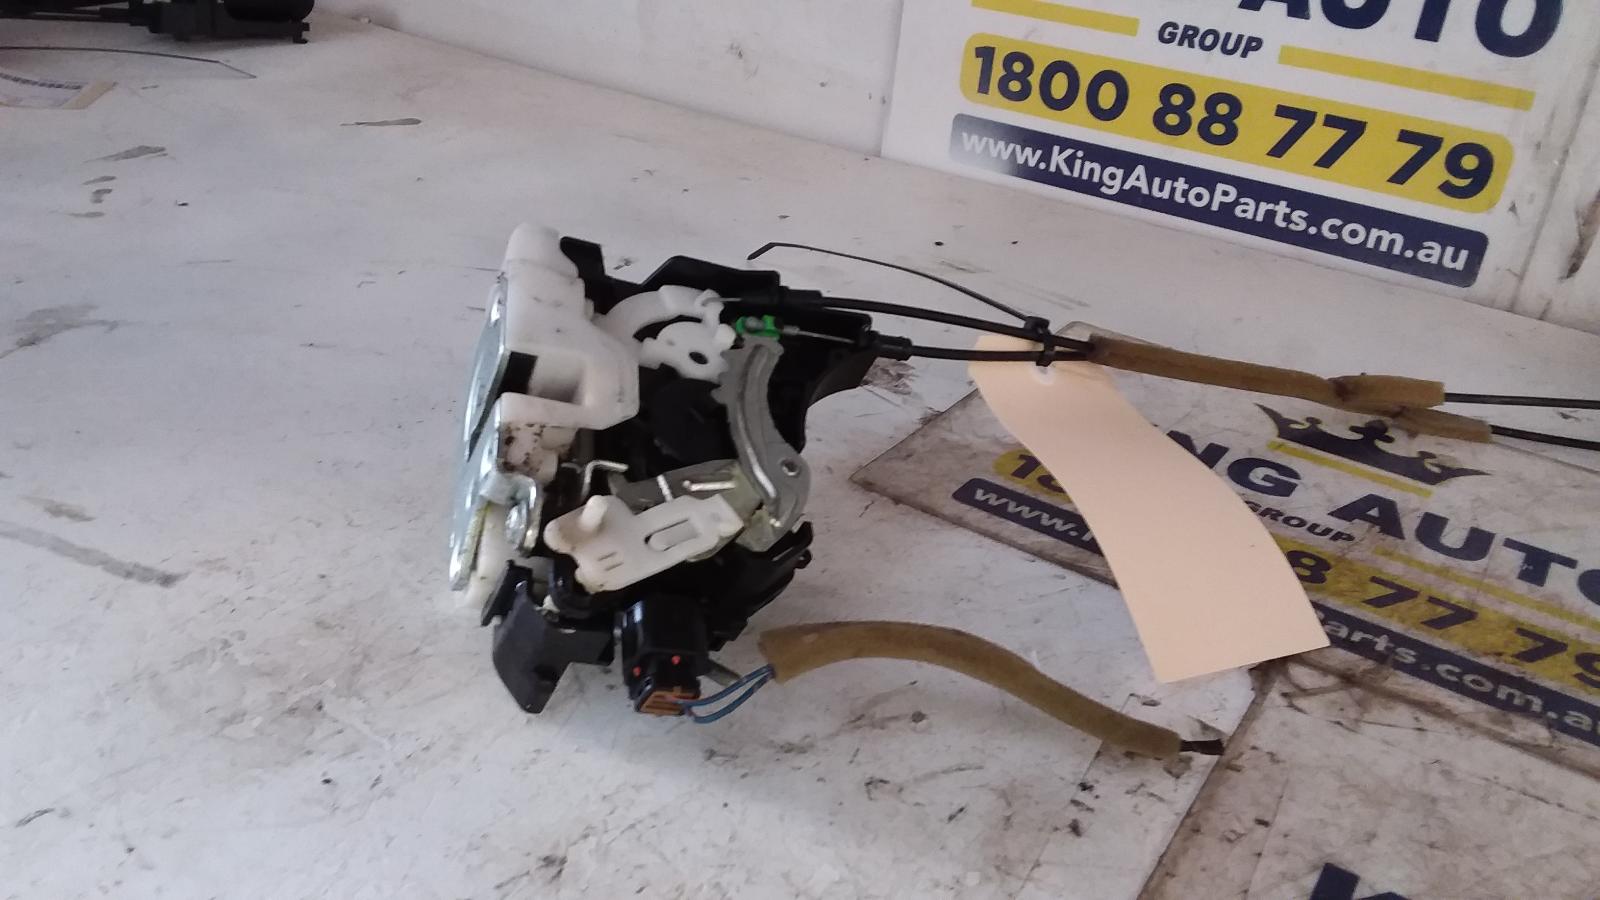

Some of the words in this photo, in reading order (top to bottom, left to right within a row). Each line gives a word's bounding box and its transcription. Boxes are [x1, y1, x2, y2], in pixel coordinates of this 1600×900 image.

[1157, 21, 1263, 59] GROUP
[1238, 0, 1563, 58] TO
[973, 46, 1129, 121] 1800
[1152, 83, 1244, 145] 88
[1266, 104, 1367, 169] 77
[1386, 129, 1494, 199] 79
[961, 128, 1470, 272] www.KingAutoParts.com.au
[1362, 576, 1478, 630] 77
[1318, 610, 1600, 736] arts.com.a
